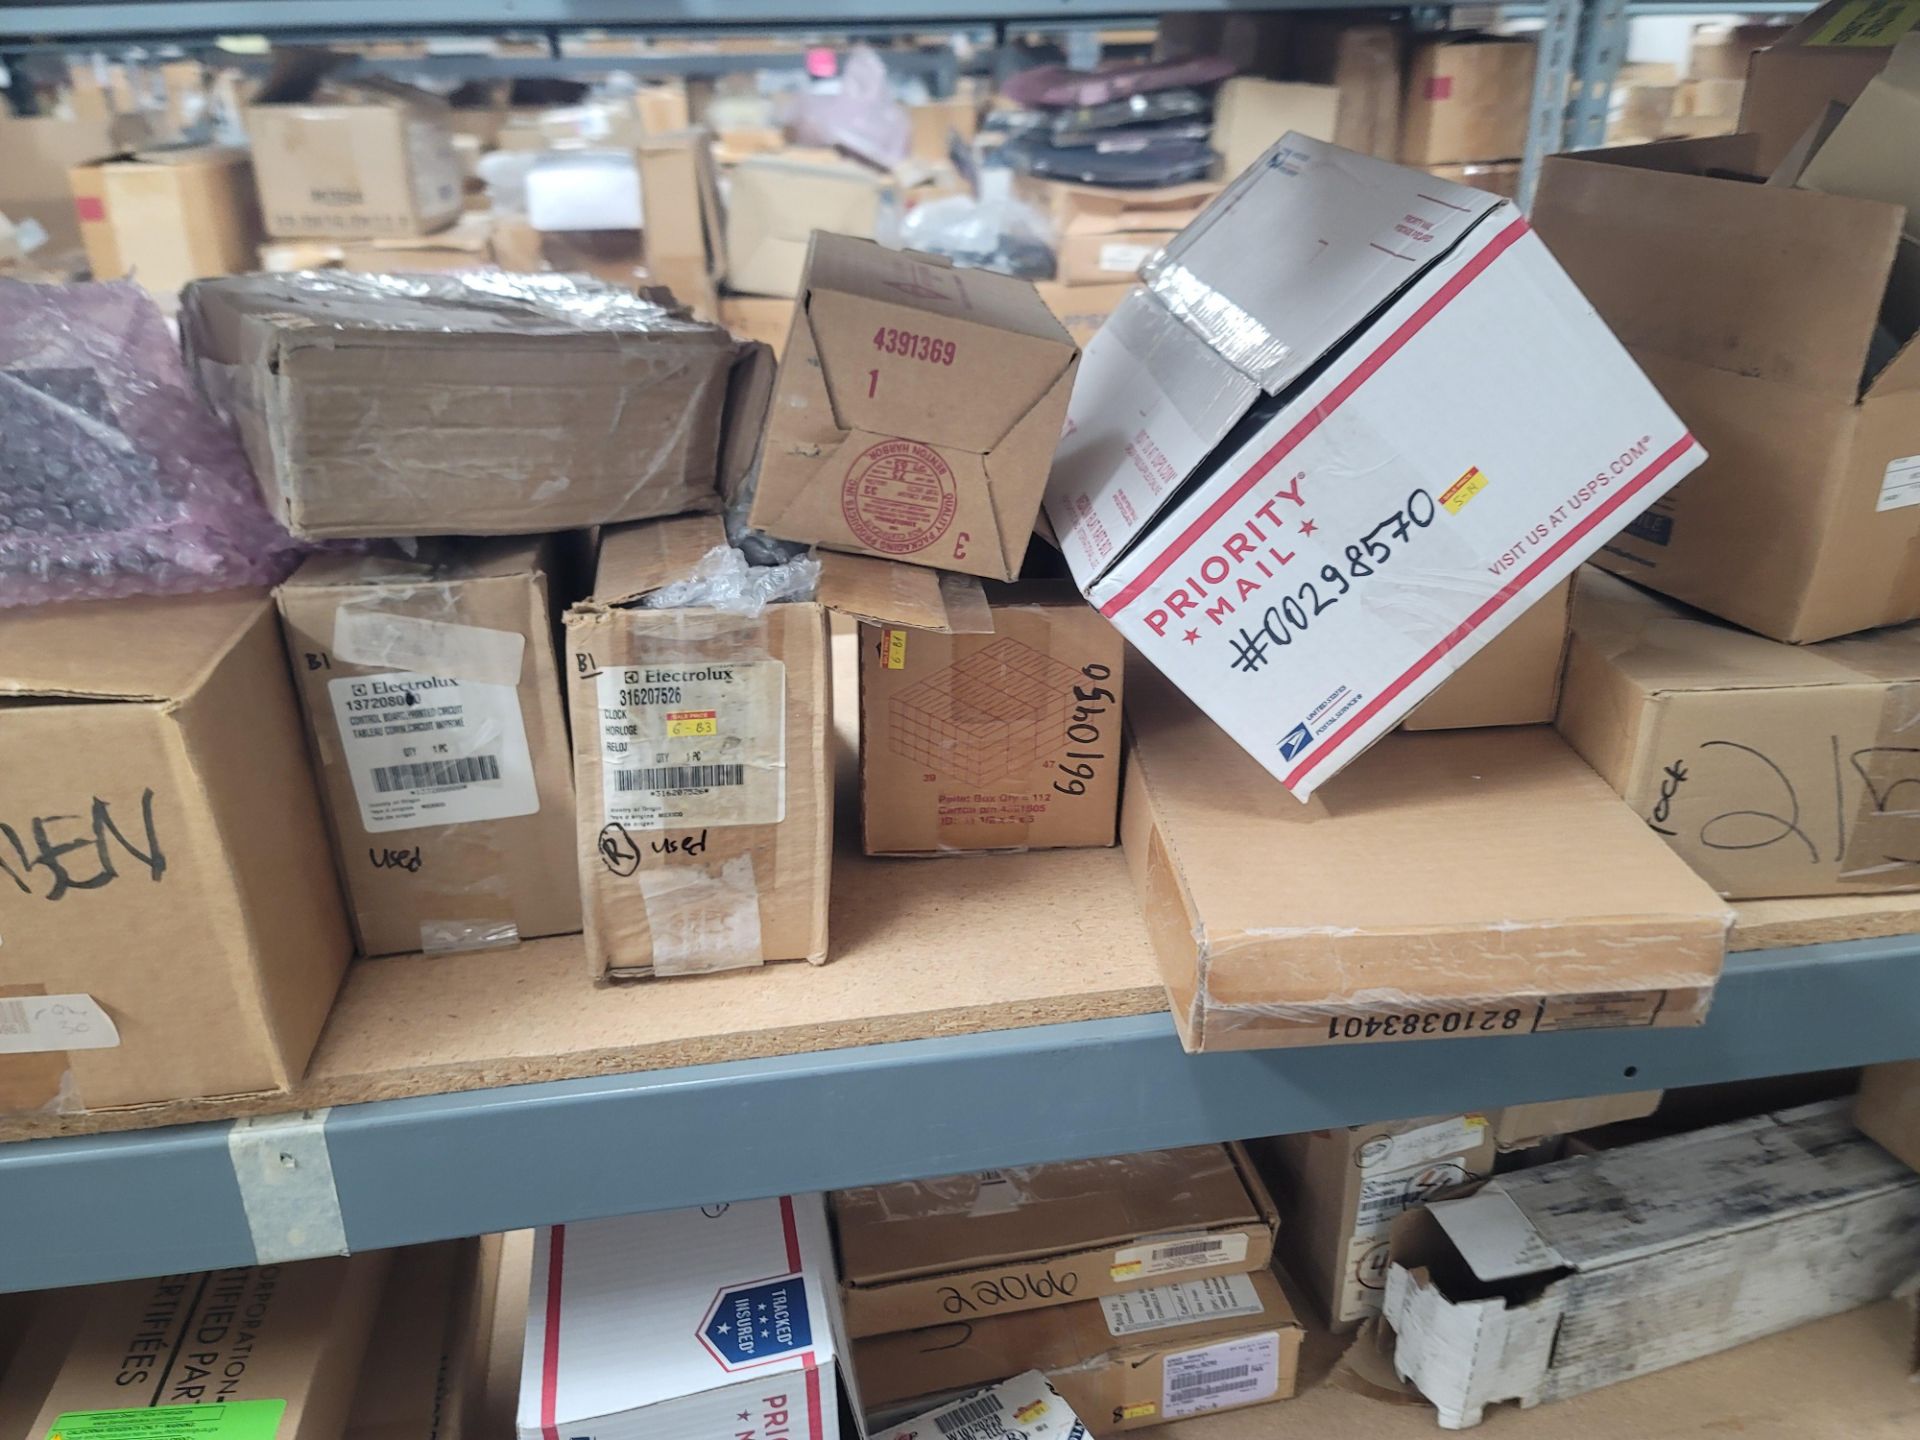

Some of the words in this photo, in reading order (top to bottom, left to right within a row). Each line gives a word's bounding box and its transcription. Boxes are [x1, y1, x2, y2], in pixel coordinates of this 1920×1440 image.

[874, 327, 956, 366] 4391369
[868, 369, 879, 398] 1
[870, 444, 910, 460] HARBOR
[913, 444, 948, 475] BENTON
[846, 500, 878, 545] PRODUCTS
[936, 492, 954, 534] QUALITY
[880, 531, 936, 552] PACKAGING
[1488, 541, 1527, 577] VISIT
[1524, 524, 1550, 546] US
[1549, 505, 1570, 528] AT
[1204, 547, 1296, 626] MAIL
[1229, 488, 1435, 672] #00298570
[576, 653, 596, 673] B1
[646, 668, 734, 684] Electrolux
[372, 676, 459, 695] Electrolux
[620, 686, 682, 706] 316207526
[346, 692, 422, 712] 13720800
[604, 708, 628, 720] CLOCK
[605, 725, 638, 736] HORLOGE
[1053, 663, 1116, 796] 6610450
[403, 747, 416, 757] QTY
[606, 742, 628, 752] RELOJ
[656, 752, 669, 764] QTY
[1328, 1008, 1522, 1040] 8210383401
[937, 1270, 1079, 1314] 22066
[172, 1352, 218, 1404] PAR
[762, 1394, 790, 1440] PRI
